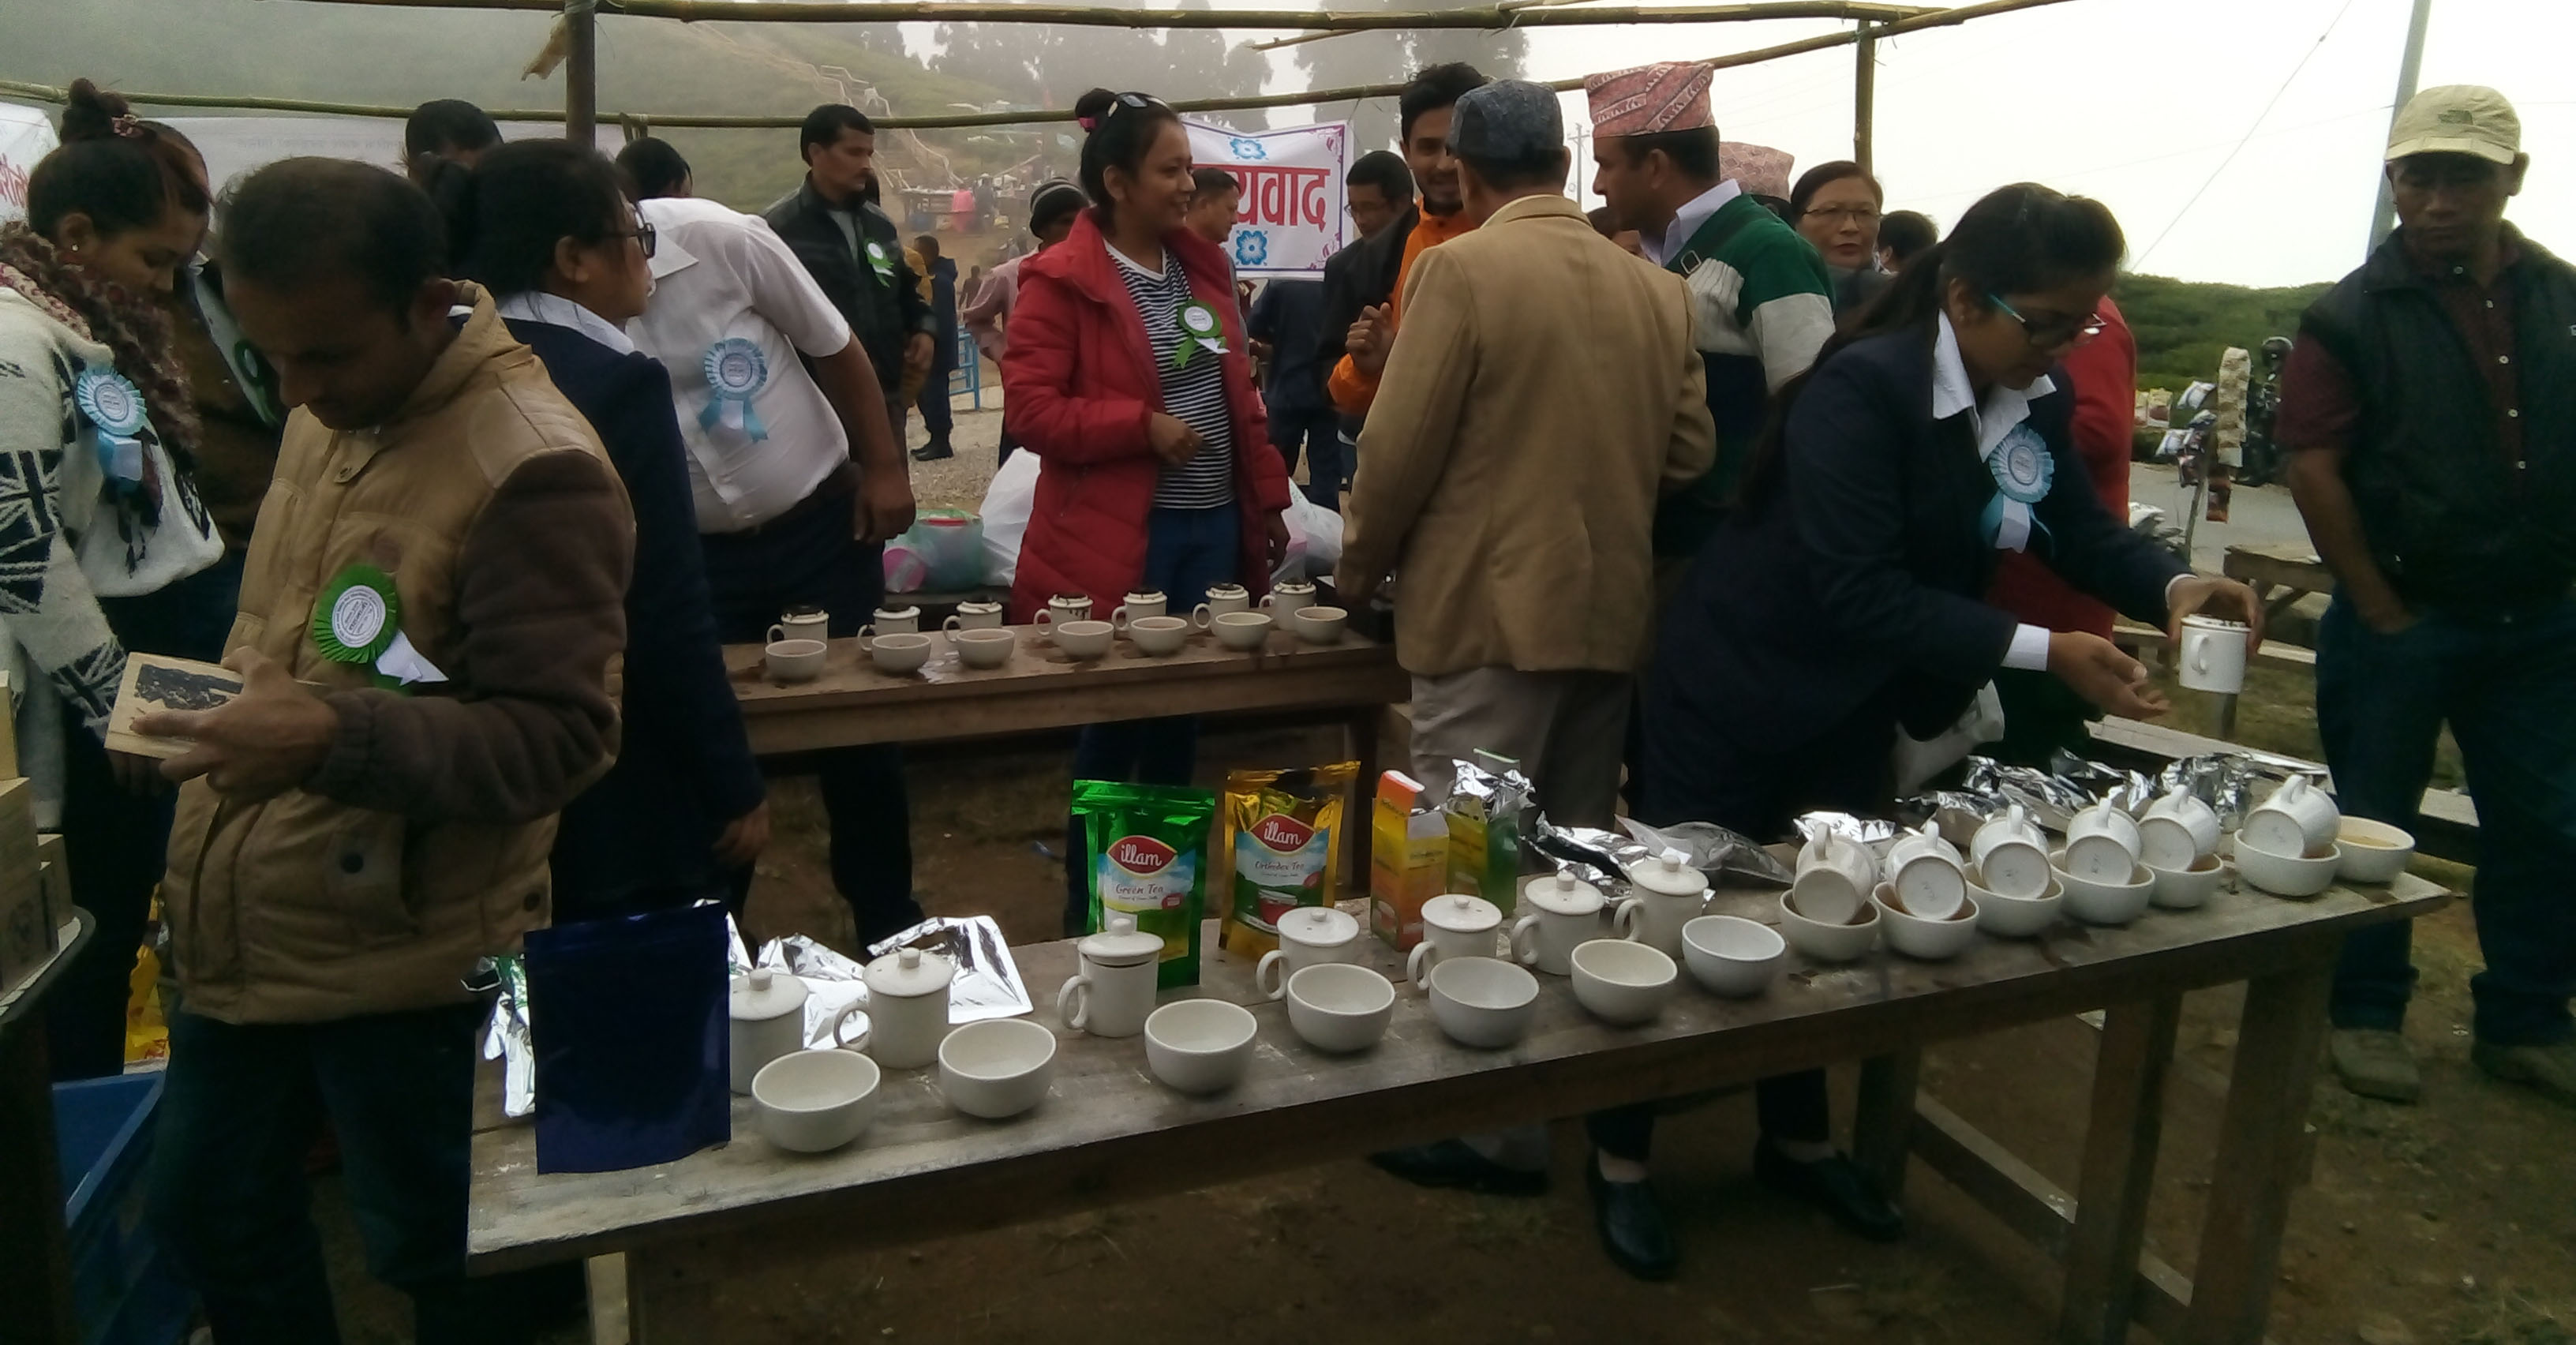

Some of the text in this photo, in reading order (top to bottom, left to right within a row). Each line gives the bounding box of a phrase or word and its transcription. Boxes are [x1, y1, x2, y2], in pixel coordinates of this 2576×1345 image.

[1264, 821, 1301, 845] illam
[1121, 844, 1162, 866] illam
[1292, 860, 1305, 870] Tea
[1116, 883, 1163, 894] Green Tea
